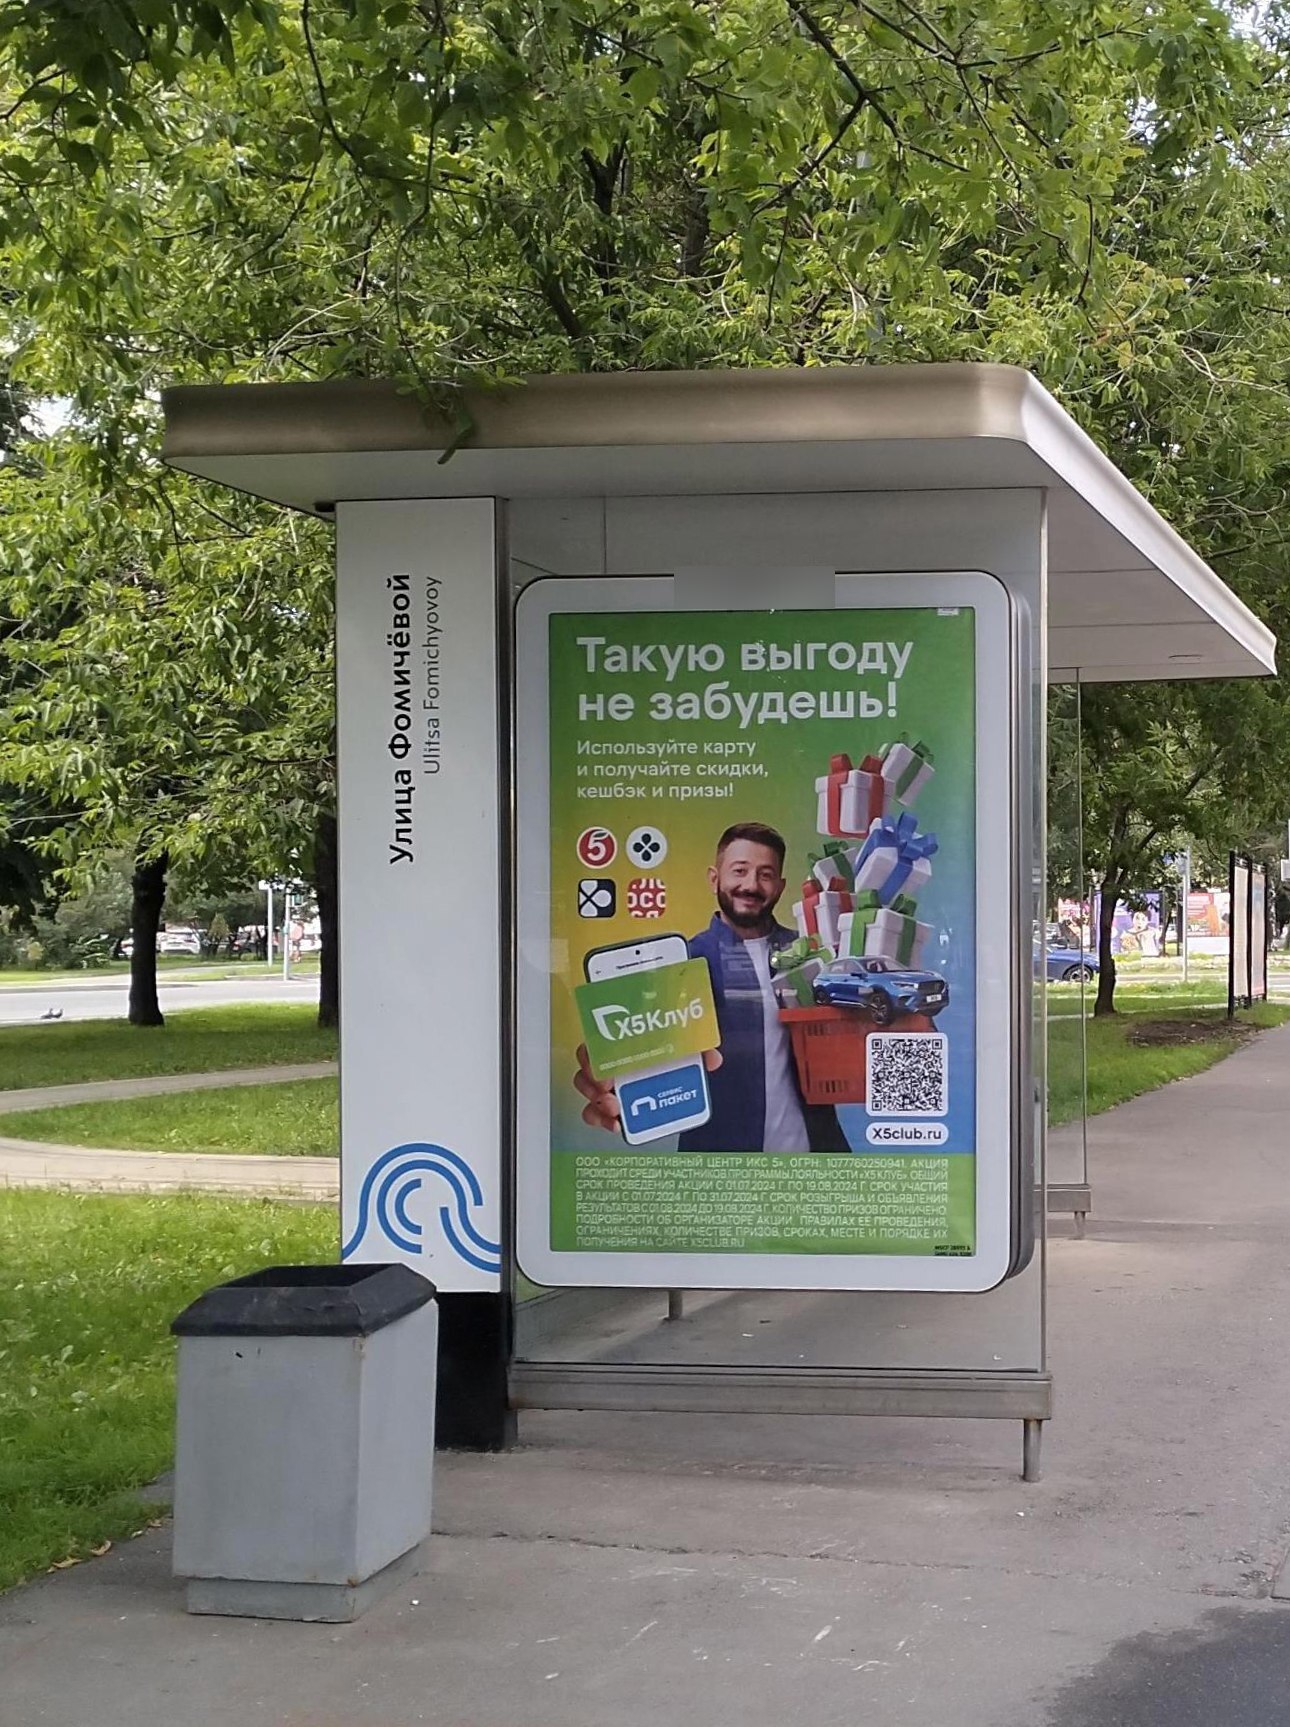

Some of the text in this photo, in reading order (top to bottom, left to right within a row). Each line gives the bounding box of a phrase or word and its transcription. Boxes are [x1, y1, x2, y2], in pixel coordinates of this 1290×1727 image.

[577, 636, 914, 682] Такую выгоду
[421, 576, 444, 775] Ulitsa Fomichyovoy
[579, 680, 897, 729] не забудешь!
[386, 574, 416, 865] Улица Фомичёвой
[577, 739, 757, 758] Используйте карту
[577, 760, 769, 780] и получайте скидки,
[577, 782, 734, 801] кешбэк и призы!
[659, 1089, 697, 1108] пакет
[872, 1127, 943, 1140] X5club.ru
[576, 1156, 600, 1167] ООО
[604, 1155, 703, 1167] «КОРПОРАТИВНЫЙ
[707, 1157, 742, 1168] ЦЕНТР
[746, 1157, 768, 1167] ИКС
[790, 1157, 822, 1167] ОГРН:
[911, 1159, 948, 1170] АКЦИЯ
[576, 1168, 627, 1178] ПРОХОДИТ
[629, 1168, 661, 1178] СРЕДИ
[663, 1168, 726, 1179] УЧАСТНИКОВ
[728, 1169, 788, 1179] ПРОГРАММЫ
[789, 1169, 857, 1180] ЛОЯЛЬНОСТИ
[576, 1180, 603, 1190] СРОК
[606, 1180, 675, 1190] ПРОВЕДЕНИЯ
[678, 1180, 712, 1191] АКЦИИ
[716, 1181, 724, 1190] С
[788, 1181, 803, 1191] ПО
[870, 1182, 897, 1191] СРОК
[900, 1182, 948, 1192] УЧАСТИЯ
[576, 1191, 583, 1201] В
[585, 1191, 619, 1202] АКЦИИ
[622, 1191, 629, 1201] С
[692, 1192, 707, 1202] ПО
[770, 1192, 798, 1202] СРОК
[800, 1193, 865, 1203] РОЗЫГРЫША
[868, 1193, 875, 1203] И
[878, 1193, 948, 1203] ОБЪЯВЛЕНИЯ
[576, 1203, 640, 1213] РЕЗУЛЬТАТОВ
[772, 1204, 837, 1214] КОЛИЧЕСТВО
[838, 1204, 878, 1215] ПРИЗОВ
[576, 1214, 654, 1224] ПОДРОБНОСТИ
[656, 1214, 672, 1225] ОБ
[674, 1214, 753, 1225] ОРГАНИЗАТОРЕ
[799, 1216, 855, 1226] ПРАВИЛАХ
[858, 1216, 871, 1226] ЕЕ
[664, 1226, 732, 1237] КОЛИЧЕСТВЕ
[830, 1228, 865, 1238] МЕСТЕ
[868, 1228, 876, 1238] И
[880, 1228, 930, 1239] ПОРЯДКЕ
[933, 1229, 948, 1239] ИХ
[576, 1236, 637, 1247] ПОЛУЧЕНИЯ
[640, 1237, 654, 1247] НА
